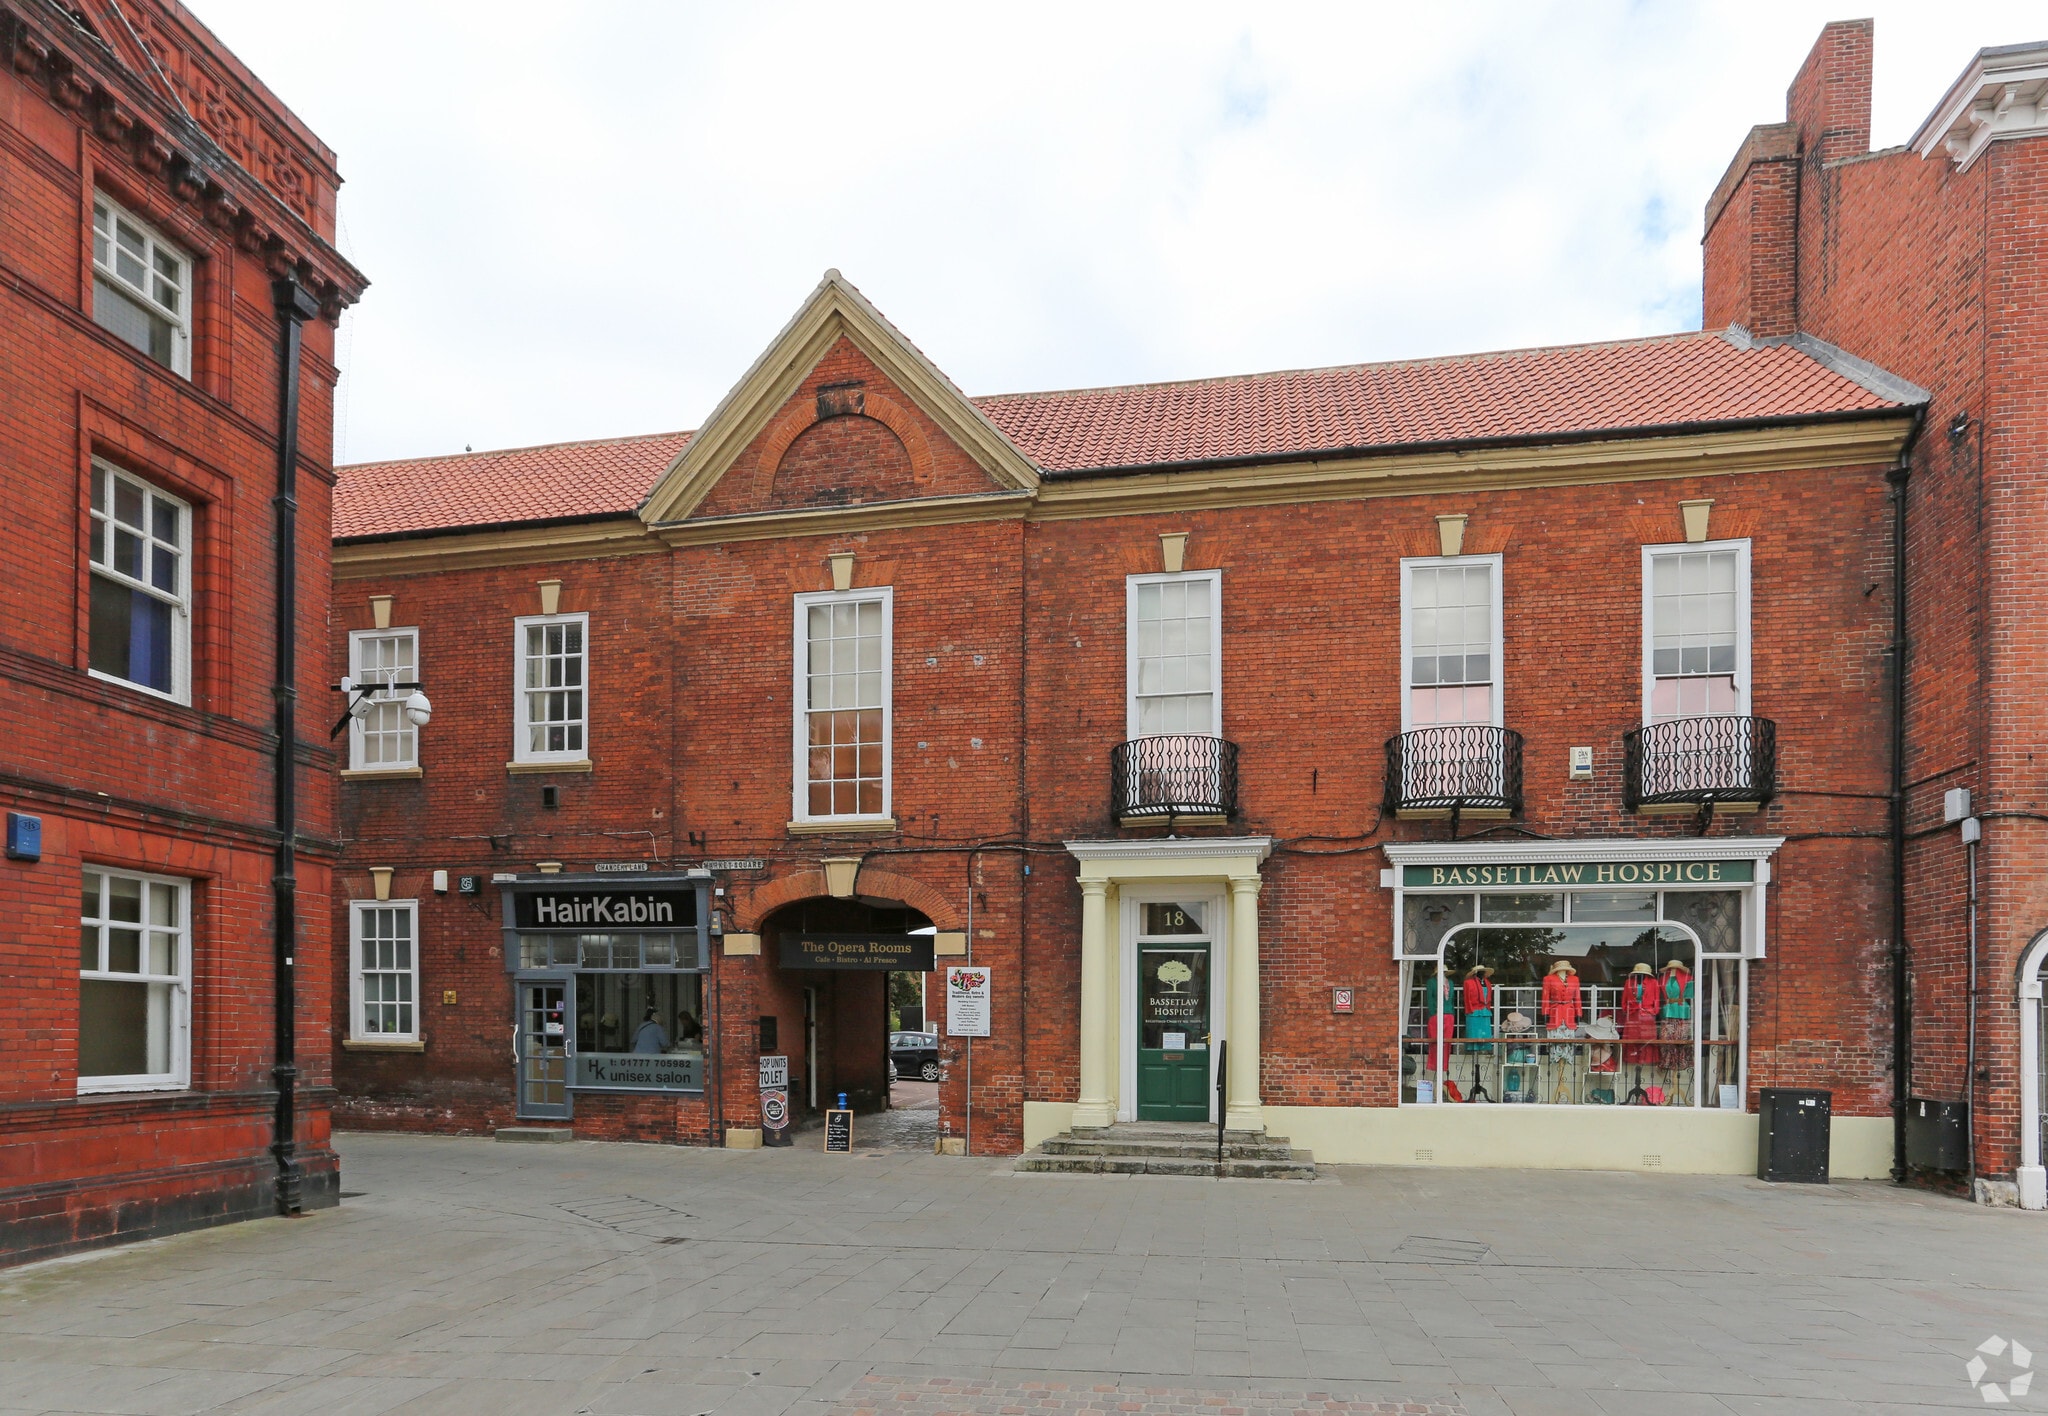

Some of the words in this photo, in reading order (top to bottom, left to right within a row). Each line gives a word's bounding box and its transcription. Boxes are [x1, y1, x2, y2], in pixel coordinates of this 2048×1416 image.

[630, 863, 646, 871] LANE
[734, 861, 762, 869] SQUARE
[1432, 865, 1584, 885] BASSETLAW
[1596, 863, 1721, 882] HOSPICE
[537, 896, 673, 923] HairKabin
[1164, 911, 1184, 926] 18
[801, 942, 825, 953] The
[828, 942, 866, 955] Opera
[869, 942, 912, 954] Rooms
[836, 956, 858, 964] Bistro
[1150, 998, 1199, 1006] BASSETLAW
[1154, 1008, 1194, 1016] HOSPICE
[620, 1059, 650, 1067] 01777
[771, 1058, 787, 1068] UNITS
[610, 1071, 651, 1083] unisex
[656, 1071, 691, 1083] salon
[760, 1071, 770, 1084] TO
[770, 1070, 783, 1084] LET
